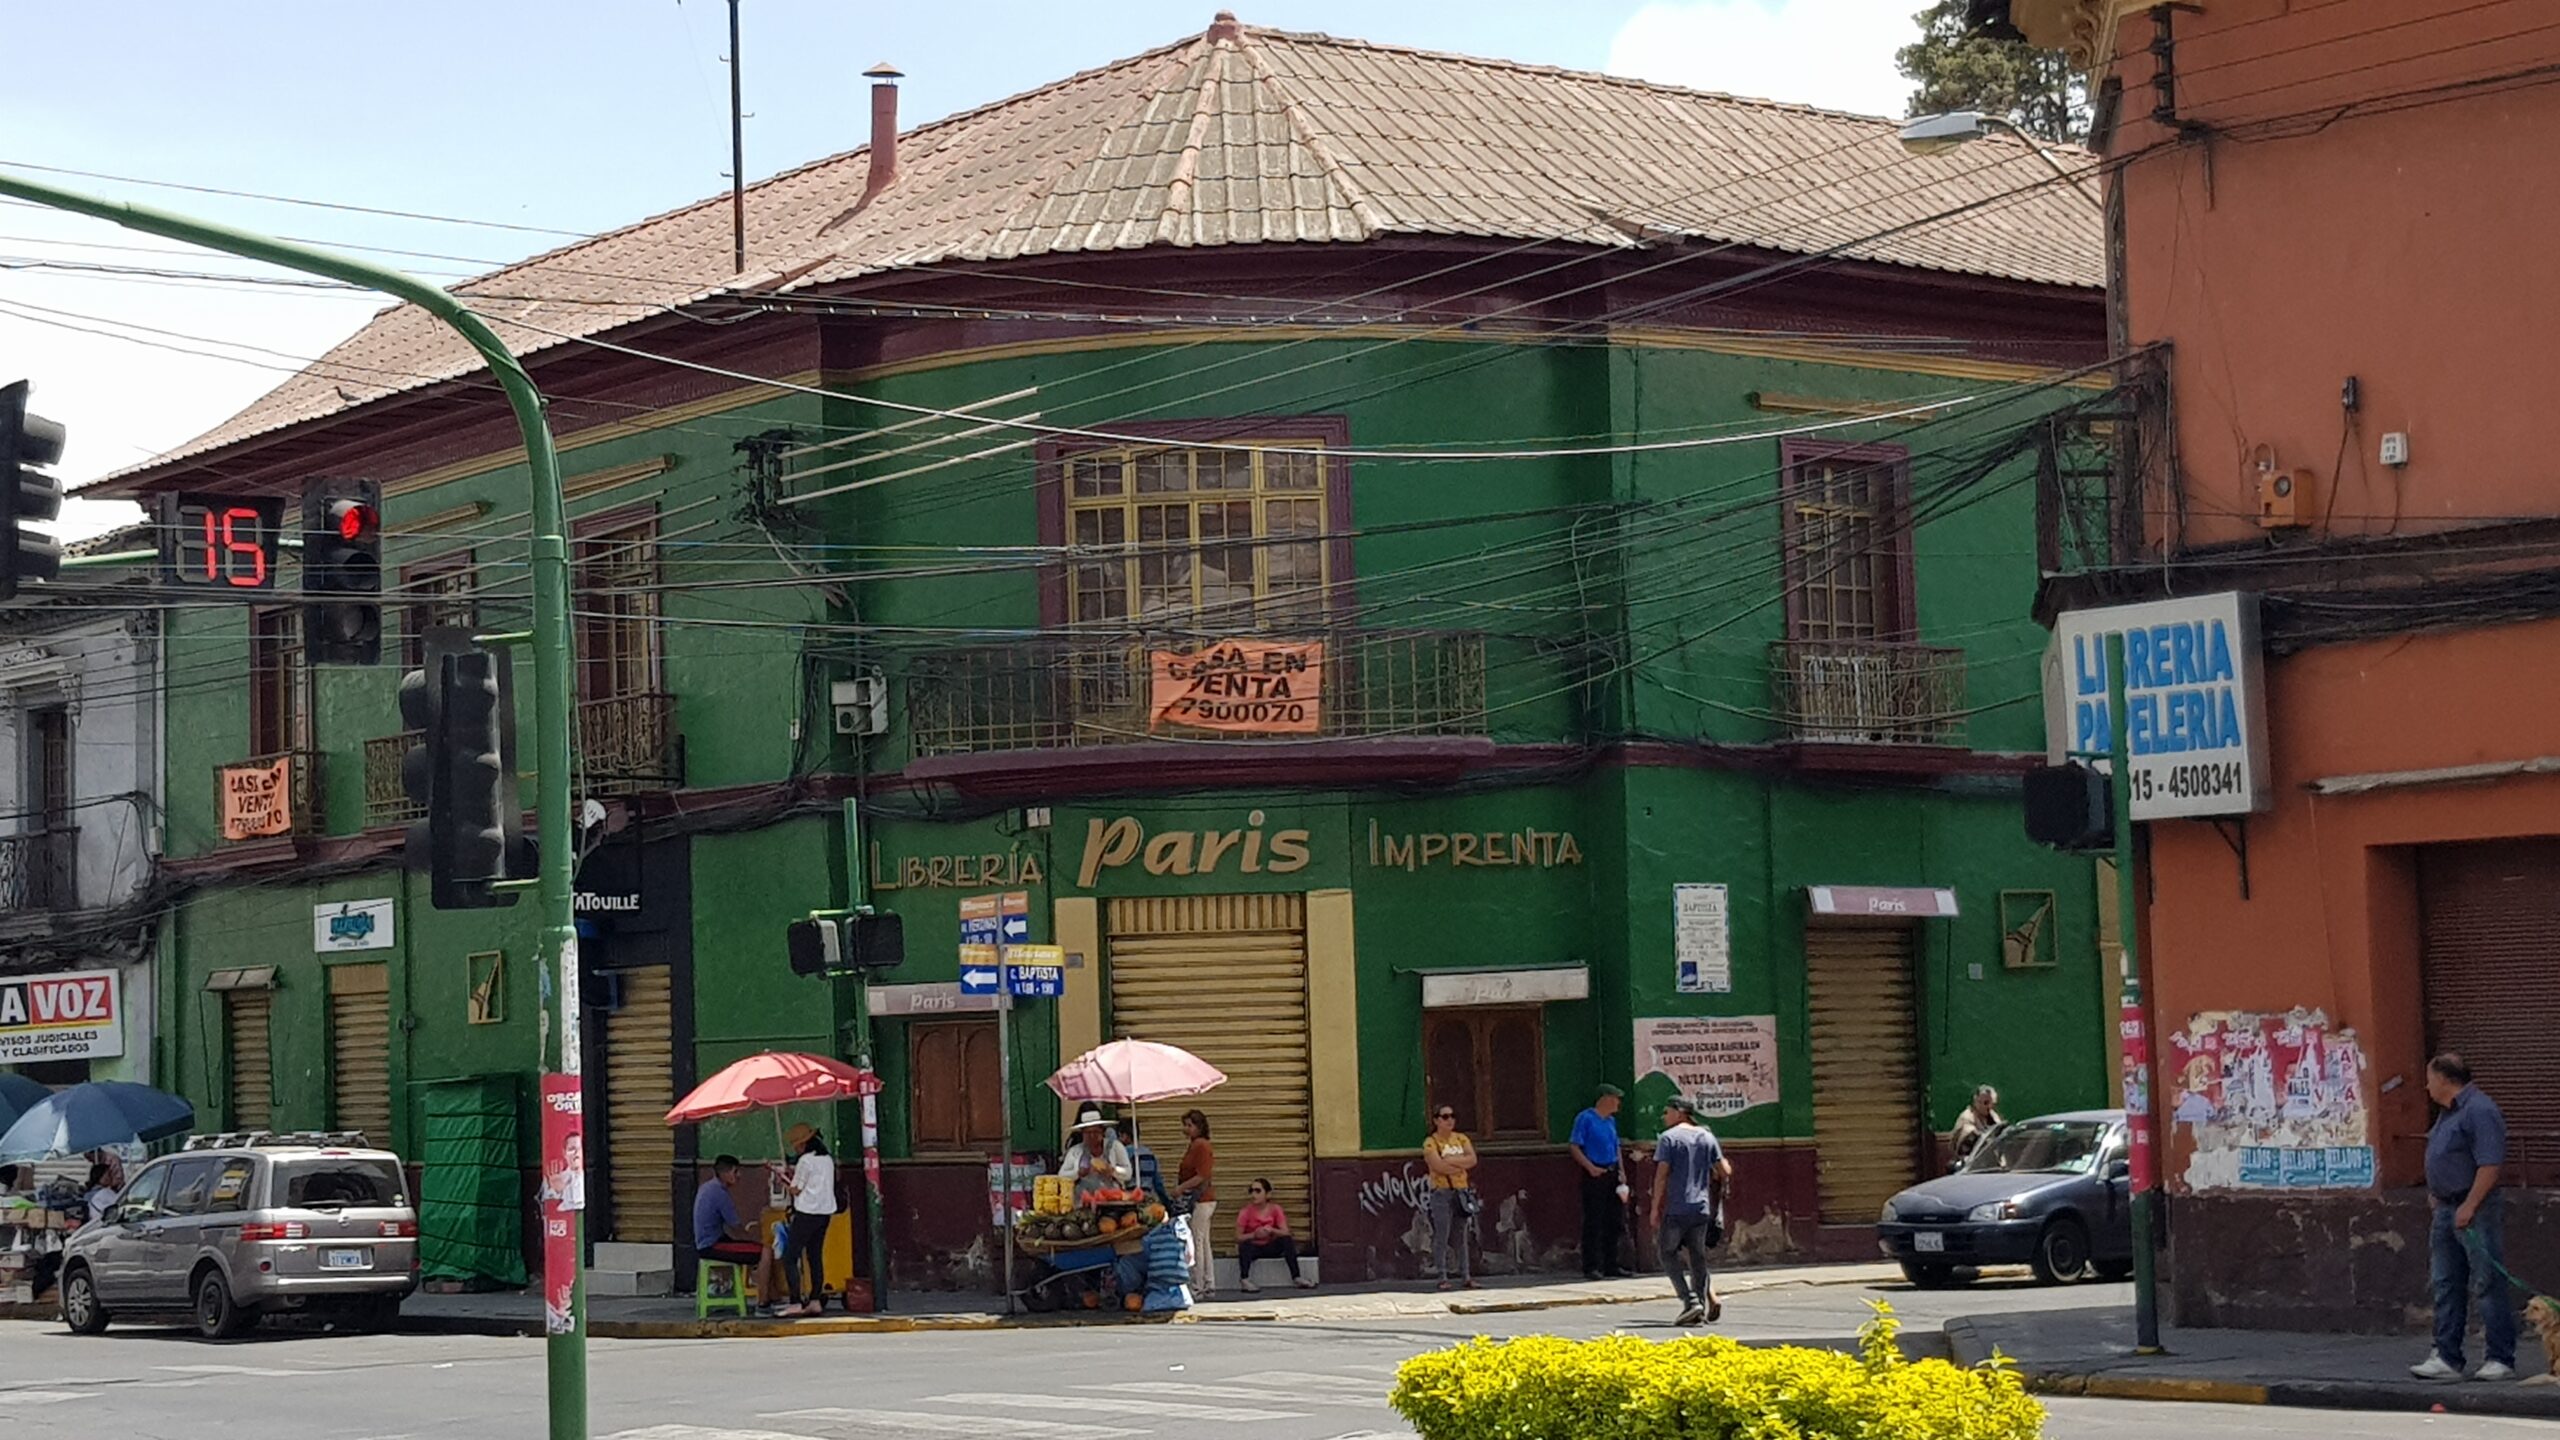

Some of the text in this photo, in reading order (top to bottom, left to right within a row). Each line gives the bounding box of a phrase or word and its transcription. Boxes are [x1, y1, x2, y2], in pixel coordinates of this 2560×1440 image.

[205, 507, 266, 587] 15
[1262, 651, 1308, 675] EN
[2074, 618, 2234, 696] LIRERIA
[2076, 685, 2242, 756] PAELERIA
[2128, 768, 2153, 801] 15
[2168, 761, 2242, 798] 4508341
[1368, 817, 1583, 872] IMPRENTA
[1018, 965, 1060, 981] BAPTISTA
[32, 980, 108, 1021] VOZ
[1, 1043, 91, 1058] Y CLASIFICADOS
[33, 1030, 99, 1045] JUDICIALES
